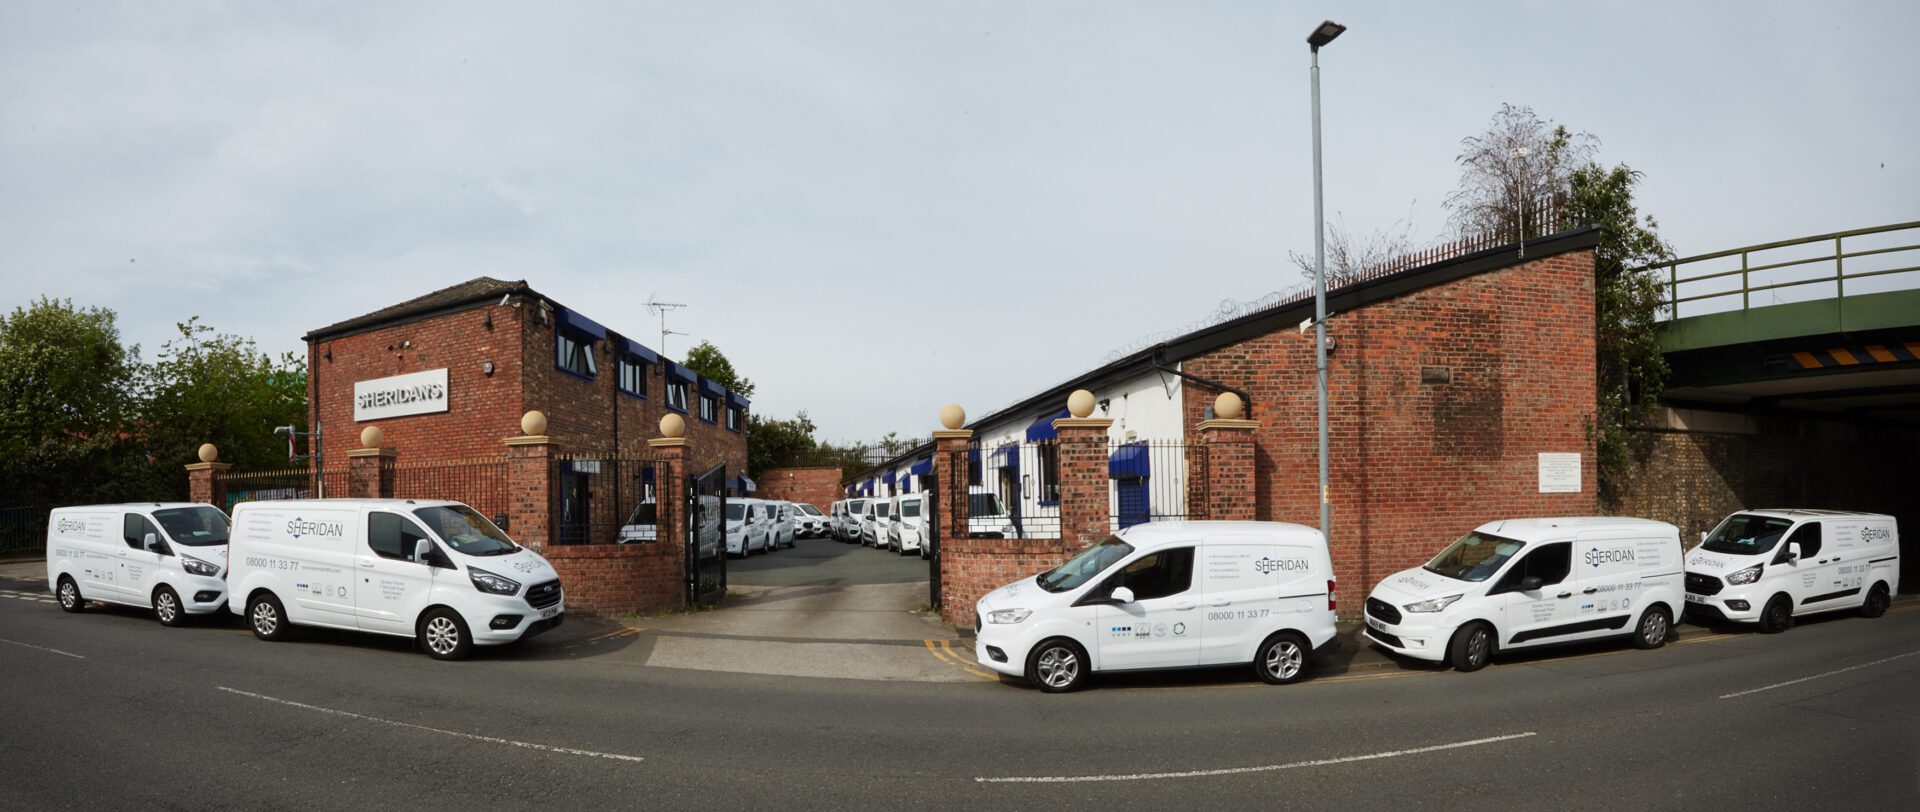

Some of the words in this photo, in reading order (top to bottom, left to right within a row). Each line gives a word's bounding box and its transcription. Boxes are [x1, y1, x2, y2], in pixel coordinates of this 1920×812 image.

[286, 520, 343, 537] SHERIDAN
[1861, 529, 1890, 541] SHERIDAN
[1585, 549, 1635, 565] SHERIDAN
[246, 557, 267, 568] 08000
[269, 559, 276, 568] 11
[278, 560, 288, 570] 33
[290, 561, 299, 571] 77
[1255, 559, 1309, 571] SHERIDAN
[1208, 611, 1234, 620] 08000
[1237, 611, 1245, 619] 11
[1248, 610, 1258, 618] 33
[1260, 609, 1270, 617] 77
